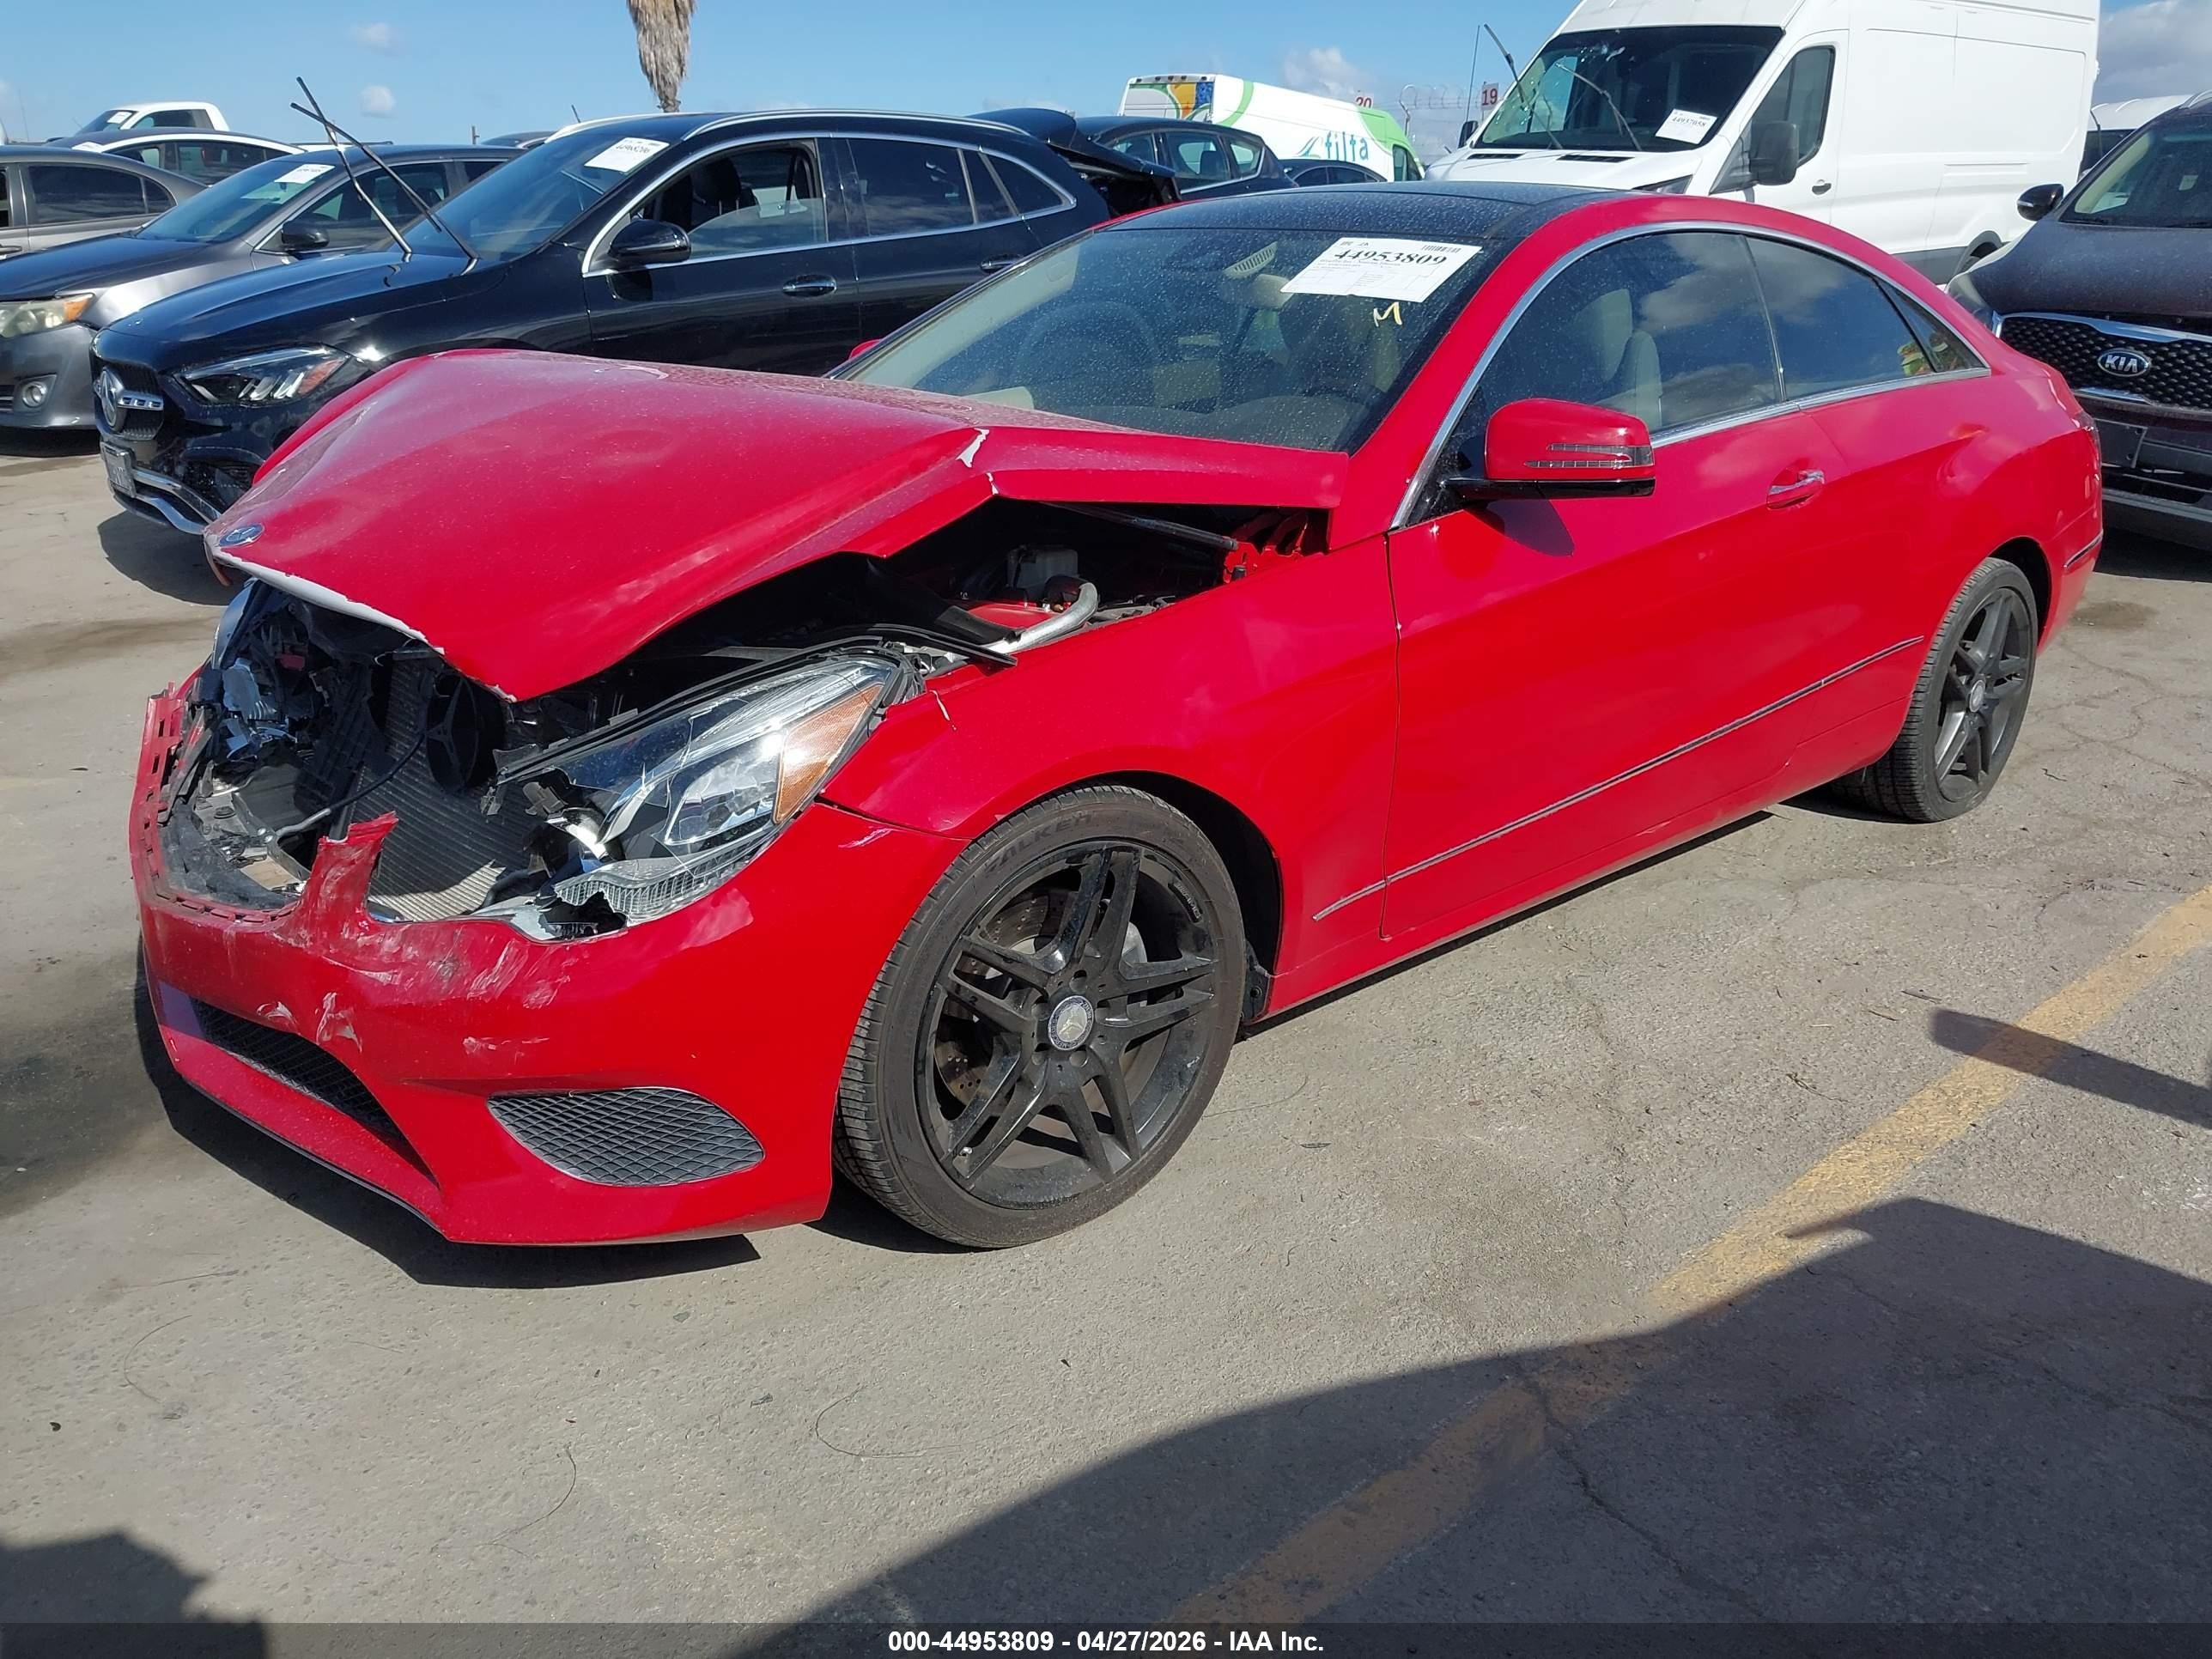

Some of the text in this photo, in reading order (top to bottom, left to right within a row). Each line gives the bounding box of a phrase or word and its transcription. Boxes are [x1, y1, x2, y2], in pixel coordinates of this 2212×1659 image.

[1482, 88, 1498, 106] 19
[1325, 131, 1369, 161] filta
[1334, 249, 1448, 265] 44953809
[1373, 301, 1403, 327] M
[2105, 355, 2138, 373] KIA
[984, 810, 1093, 875] FALKEN
